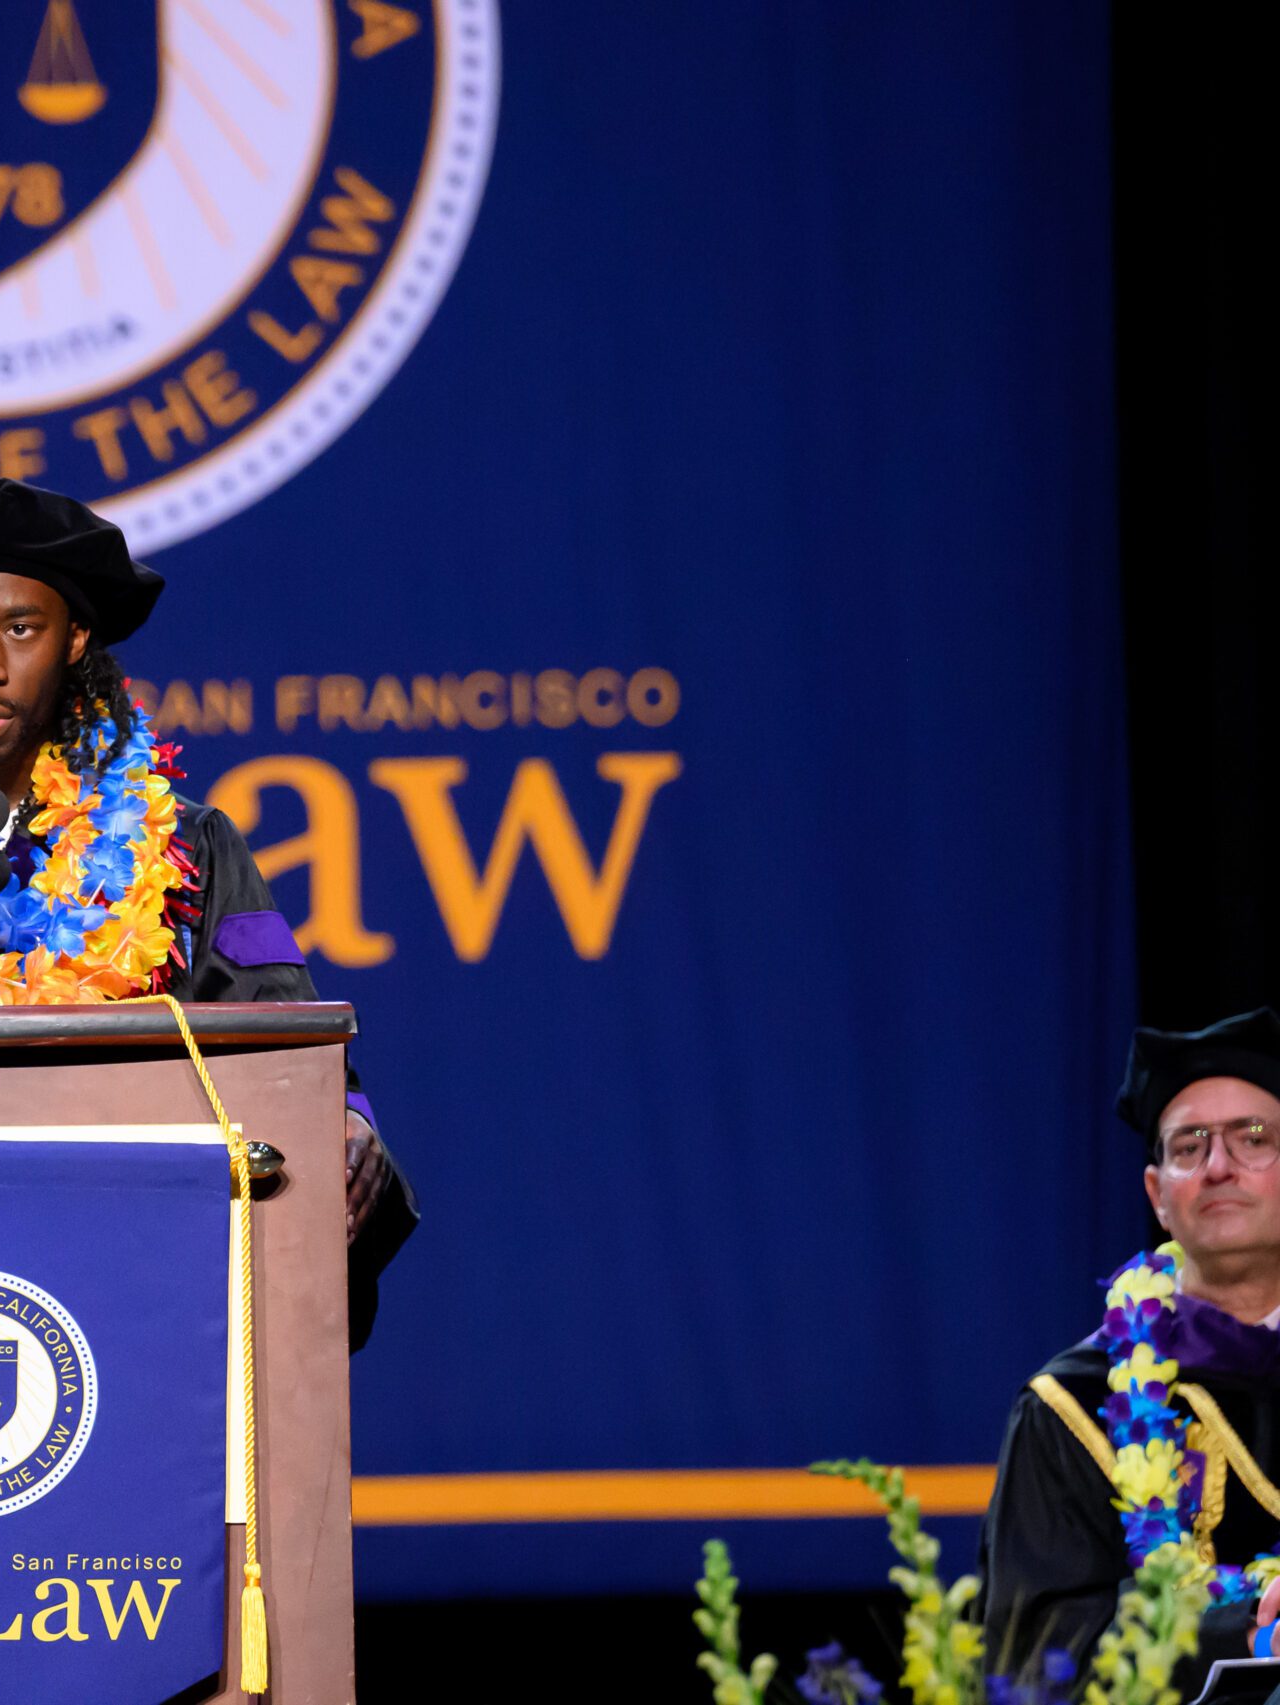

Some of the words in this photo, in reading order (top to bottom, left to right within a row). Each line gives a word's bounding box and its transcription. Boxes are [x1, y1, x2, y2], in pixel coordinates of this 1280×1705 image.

[72, 349, 257, 481] THE
[248, 165, 396, 364] LAW
[274, 667, 681, 733] FRANCISCO
[204, 750, 683, 969] aw
[35, 1423, 71, 1469] LAW
[12, 1553, 54, 1571] San
[67, 1553, 183, 1571] Francisco
